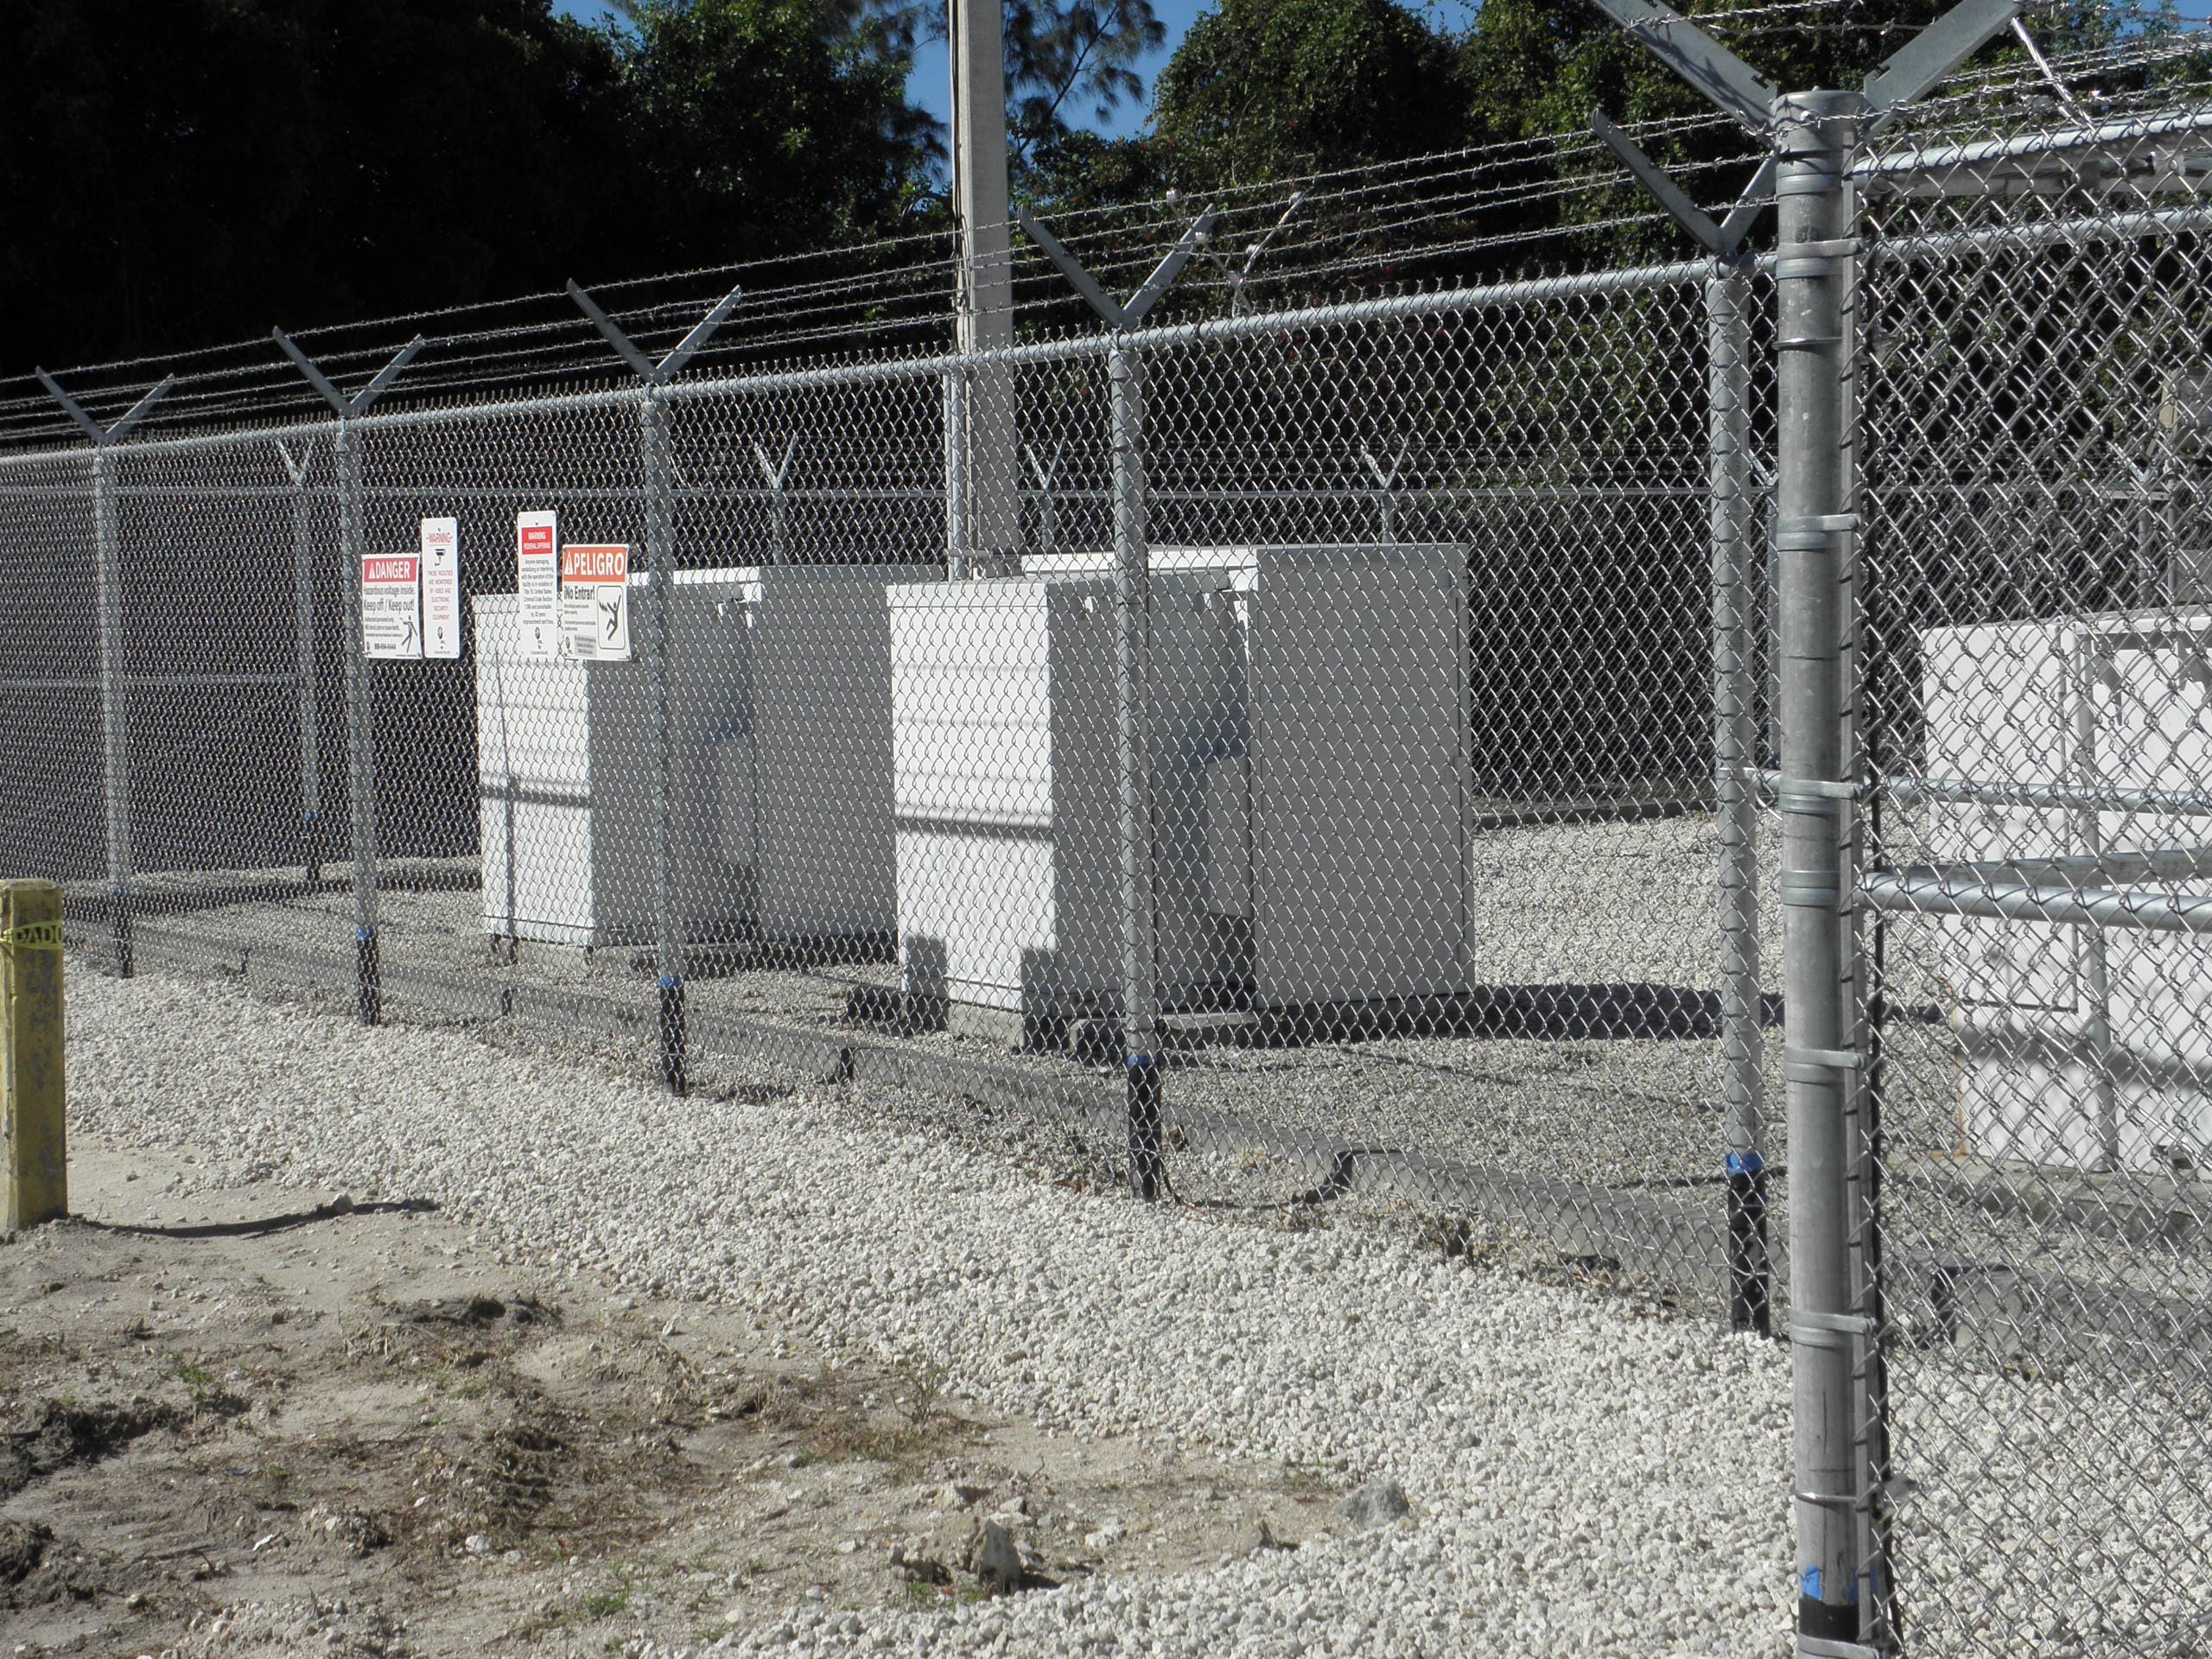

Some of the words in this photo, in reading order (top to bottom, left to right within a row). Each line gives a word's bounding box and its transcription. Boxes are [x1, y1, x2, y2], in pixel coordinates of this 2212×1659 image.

[528, 531, 546, 540] WARNING
[375, 561, 410, 578] DANGER
[574, 552, 624, 575] PELIGRO
[384, 585, 400, 598] voltage
[574, 585, 595, 601] Entrar!
[364, 599, 376, 615] Keep
[388, 599, 402, 615] Keep
[403, 599, 415, 611] out!
